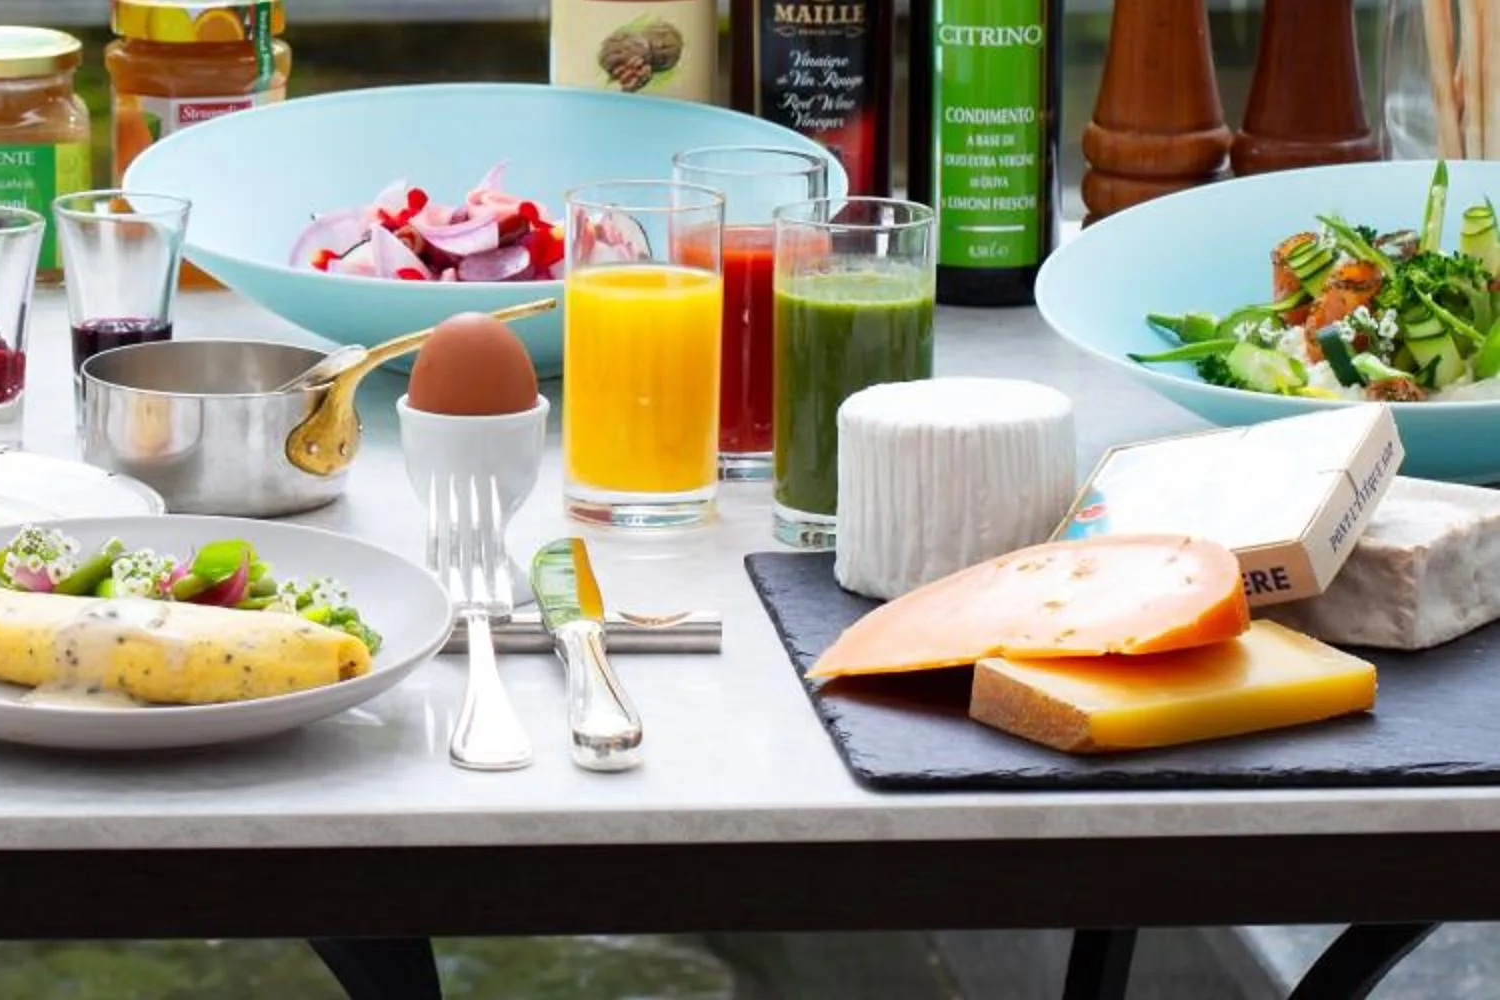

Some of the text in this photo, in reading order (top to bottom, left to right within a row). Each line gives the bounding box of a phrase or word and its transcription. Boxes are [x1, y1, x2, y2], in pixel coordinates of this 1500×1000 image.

[774, 4, 865, 23] MAILLE
[938, 24, 1042, 46] CITRINO
[789, 49, 849, 77] Vinaigre
[790, 70, 815, 87] Vin
[945, 106, 1035, 125] CONDIMENTO
